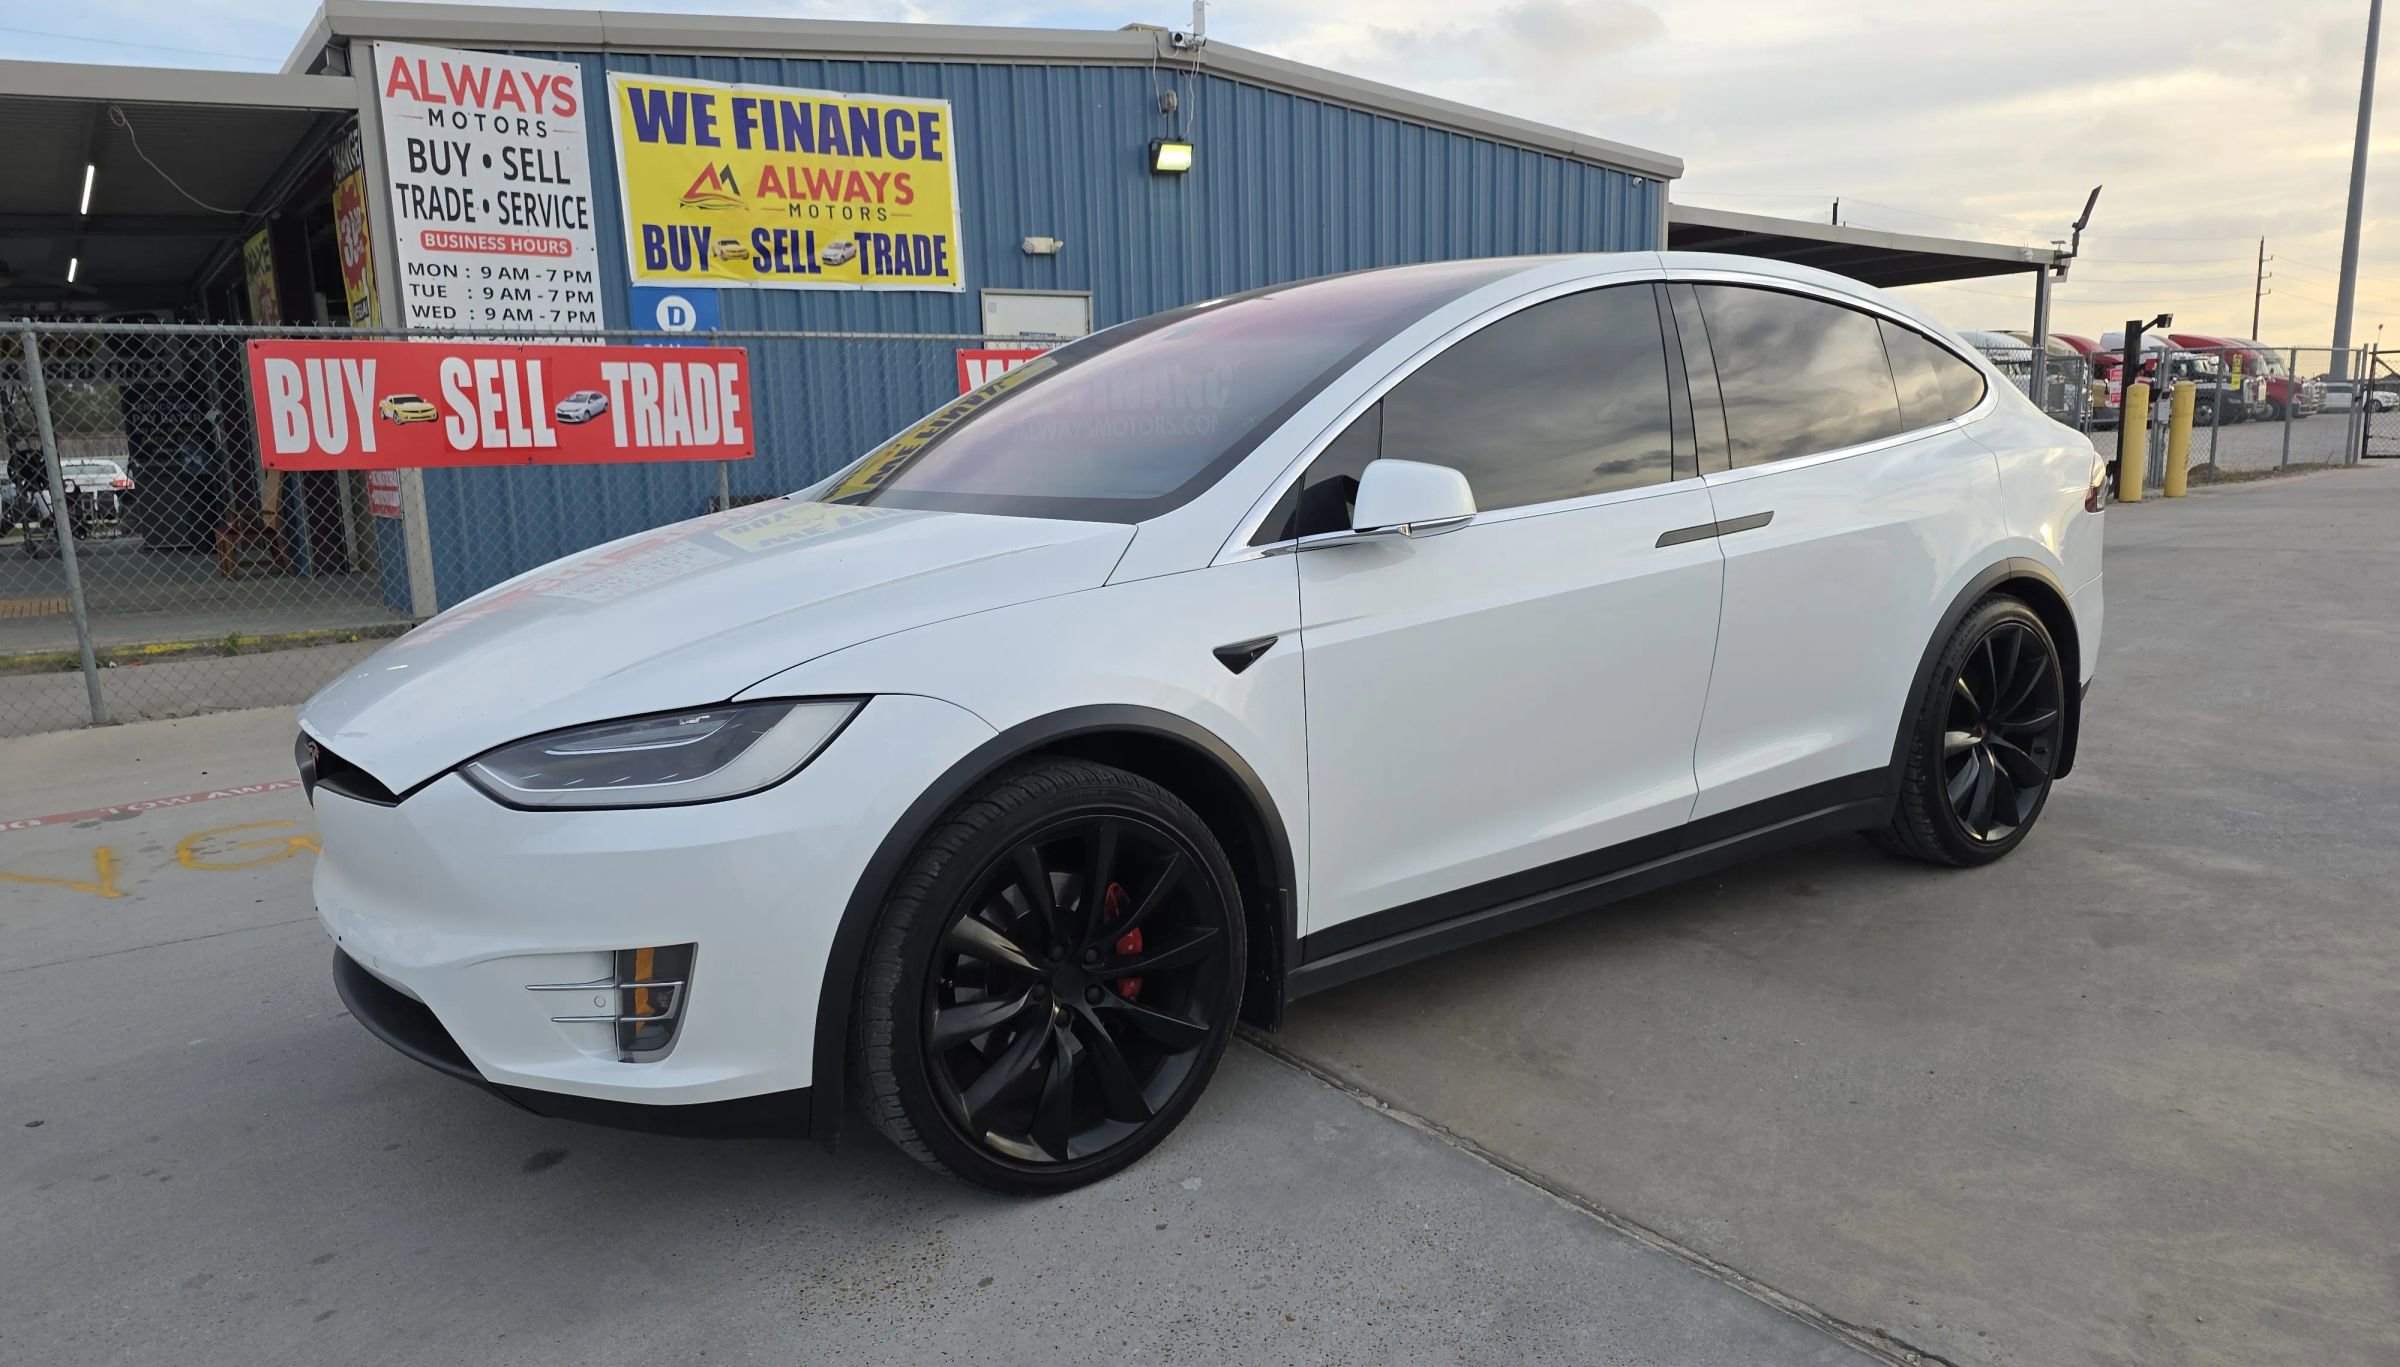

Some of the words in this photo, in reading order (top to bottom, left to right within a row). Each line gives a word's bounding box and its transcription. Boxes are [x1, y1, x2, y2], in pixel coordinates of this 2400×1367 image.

[386, 56, 577, 117] ALWAYS
[428, 108, 547, 138] MOTORS
[627, 87, 721, 148] WE
[732, 97, 943, 162] FINANCE
[407, 137, 471, 176] BUY
[502, 146, 570, 184] SELL
[757, 164, 914, 205] ALWAYS
[396, 183, 476, 223] TRADE
[497, 190, 588, 229] SERVICE
[789, 203, 887, 221] MOTORS
[425, 233, 506, 251] BUSINESS
[511, 238, 568, 254] HOURS
[642, 223, 712, 272] BUY
[751, 227, 822, 274] SELL
[854, 231, 949, 277] TRADE
[408, 262, 458, 278] MON
[480, 266, 492, 279] 9
[498, 267, 529, 281] AM
[546, 269, 557, 283] 7
[564, 270, 592, 284] PM
[409, 283, 447, 298] TUE
[483, 287, 494, 300] 9
[500, 288, 531, 301] AM
[548, 290, 559, 303] 7
[566, 290, 594, 304] PM
[412, 304, 457, 319] WED
[485, 307, 496, 321] 9
[502, 308, 533, 322] AM
[550, 310, 561, 323] 7
[568, 311, 596, 324] PM
[668, 306, 686, 326] D
[42, 362, 95, 380] SED
[264, 357, 377, 455] BUY
[439, 356, 557, 451] SELL
[600, 361, 744, 448] TRADE
[100, 796, 192, 814] TOW
